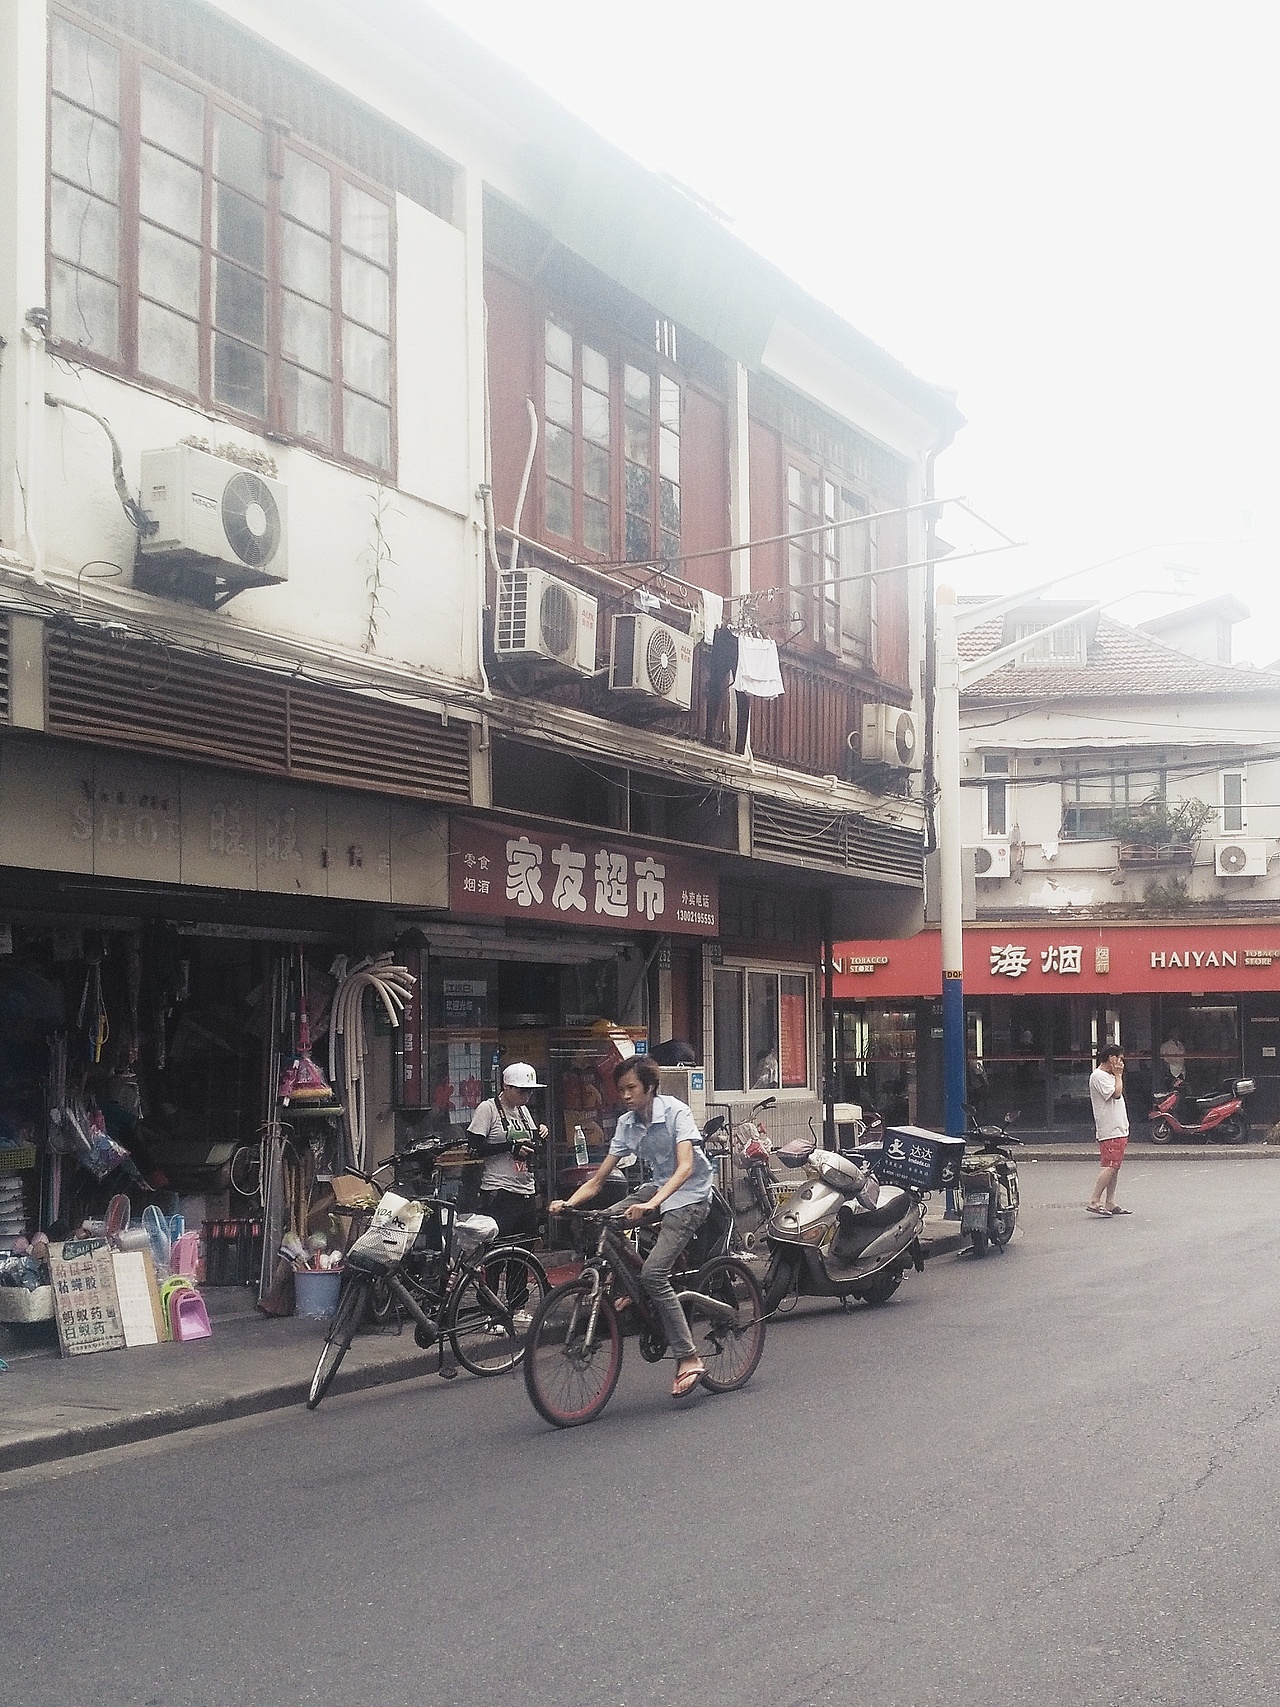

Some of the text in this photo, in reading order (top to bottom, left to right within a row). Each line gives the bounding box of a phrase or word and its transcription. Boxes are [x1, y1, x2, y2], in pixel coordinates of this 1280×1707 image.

[463, 852, 491, 871] 零食
[463, 877, 491, 895] 烟酒
[505, 835, 666, 921] 家友超市
[681, 890, 710, 909] 外卖电话
[849, 956, 889, 964] TOBACCO
[989, 943, 1083, 977] 海烟
[1150, 950, 1237, 968] HAIYAN
[1244, 957, 1272, 966] STORE
[849, 965, 875, 973] STORE
[910, 1144, 933, 1161] 达达
[61, 1306, 104, 1326] 蚂蚁药
[64, 1322, 106, 1341] 白蚁药
